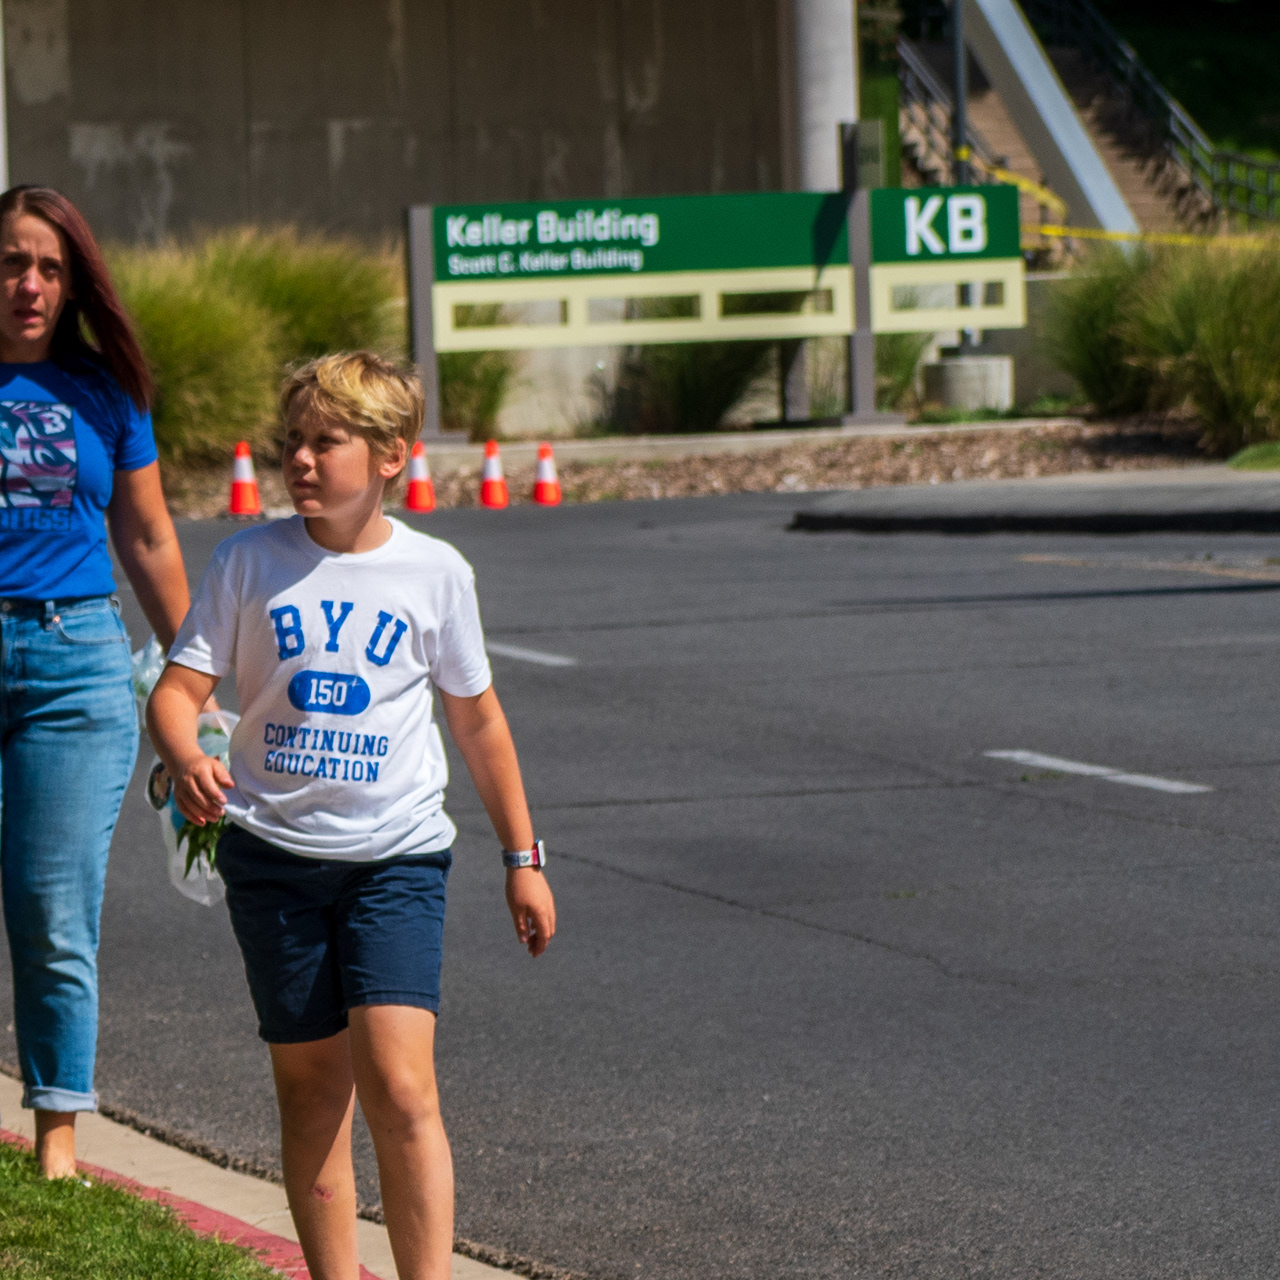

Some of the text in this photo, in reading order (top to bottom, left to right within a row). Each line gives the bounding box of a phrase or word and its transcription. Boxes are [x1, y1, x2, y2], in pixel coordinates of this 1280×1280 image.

[446, 208, 659, 247] Keller Building
[904, 193, 987, 256] KB
[448, 252, 496, 275] Scott
[519, 249, 570, 272] Keller
[570, 247, 644, 271] Building
[269, 600, 408, 667] BYU
[308, 678, 349, 707] 150
[264, 723, 389, 758] CONTINUING
[264, 750, 380, 783] EDUCATION
